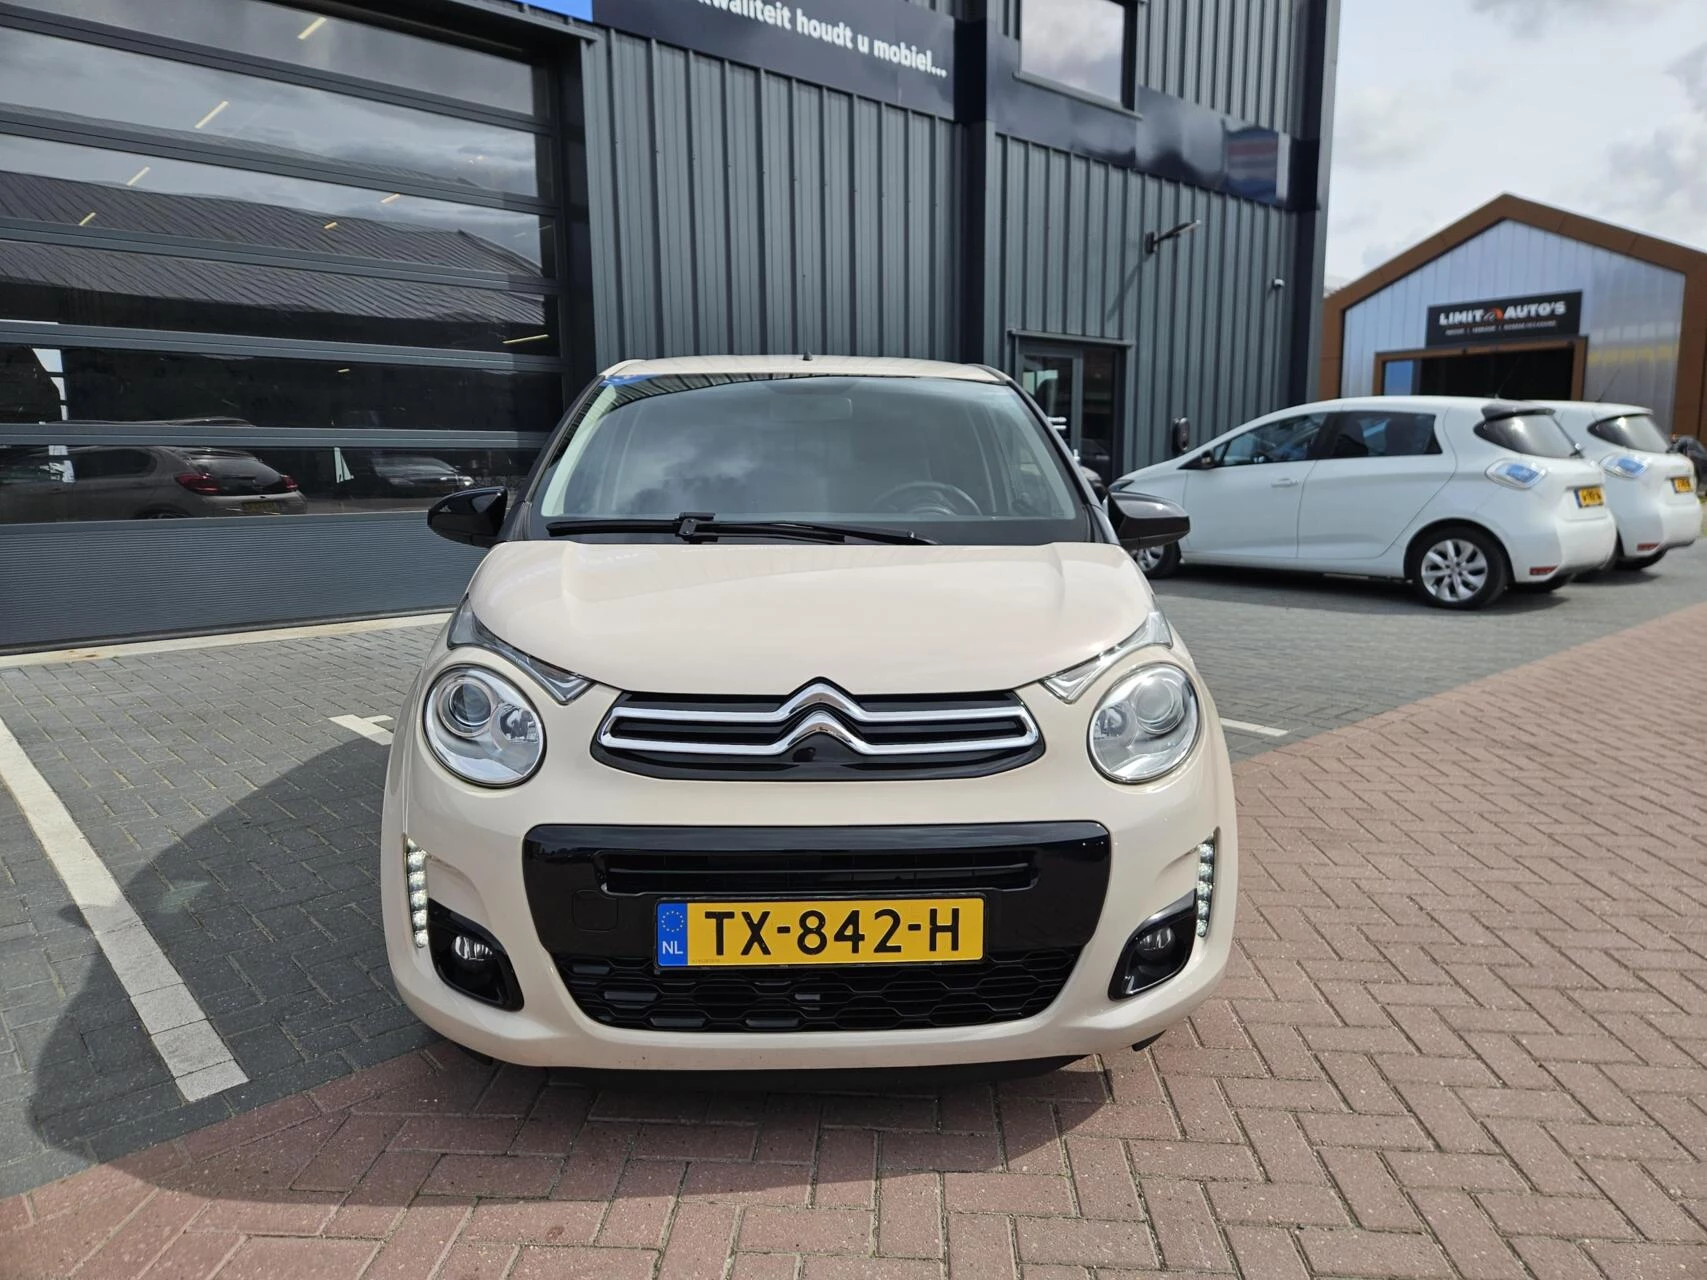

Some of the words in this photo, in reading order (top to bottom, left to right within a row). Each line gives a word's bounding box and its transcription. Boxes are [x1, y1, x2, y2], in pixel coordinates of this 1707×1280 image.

[697, 0, 792, 30] waliteit
[796, 8, 853, 49] houdt
[857, 34, 869, 54] u
[873, 39, 947, 78] mobiel...
[1439, 308, 1485, 326] LIMIT
[1503, 300, 1567, 319] AUTO'S
[662, 940, 684, 955] NL
[704, 907, 960, 956] TX-842-H
